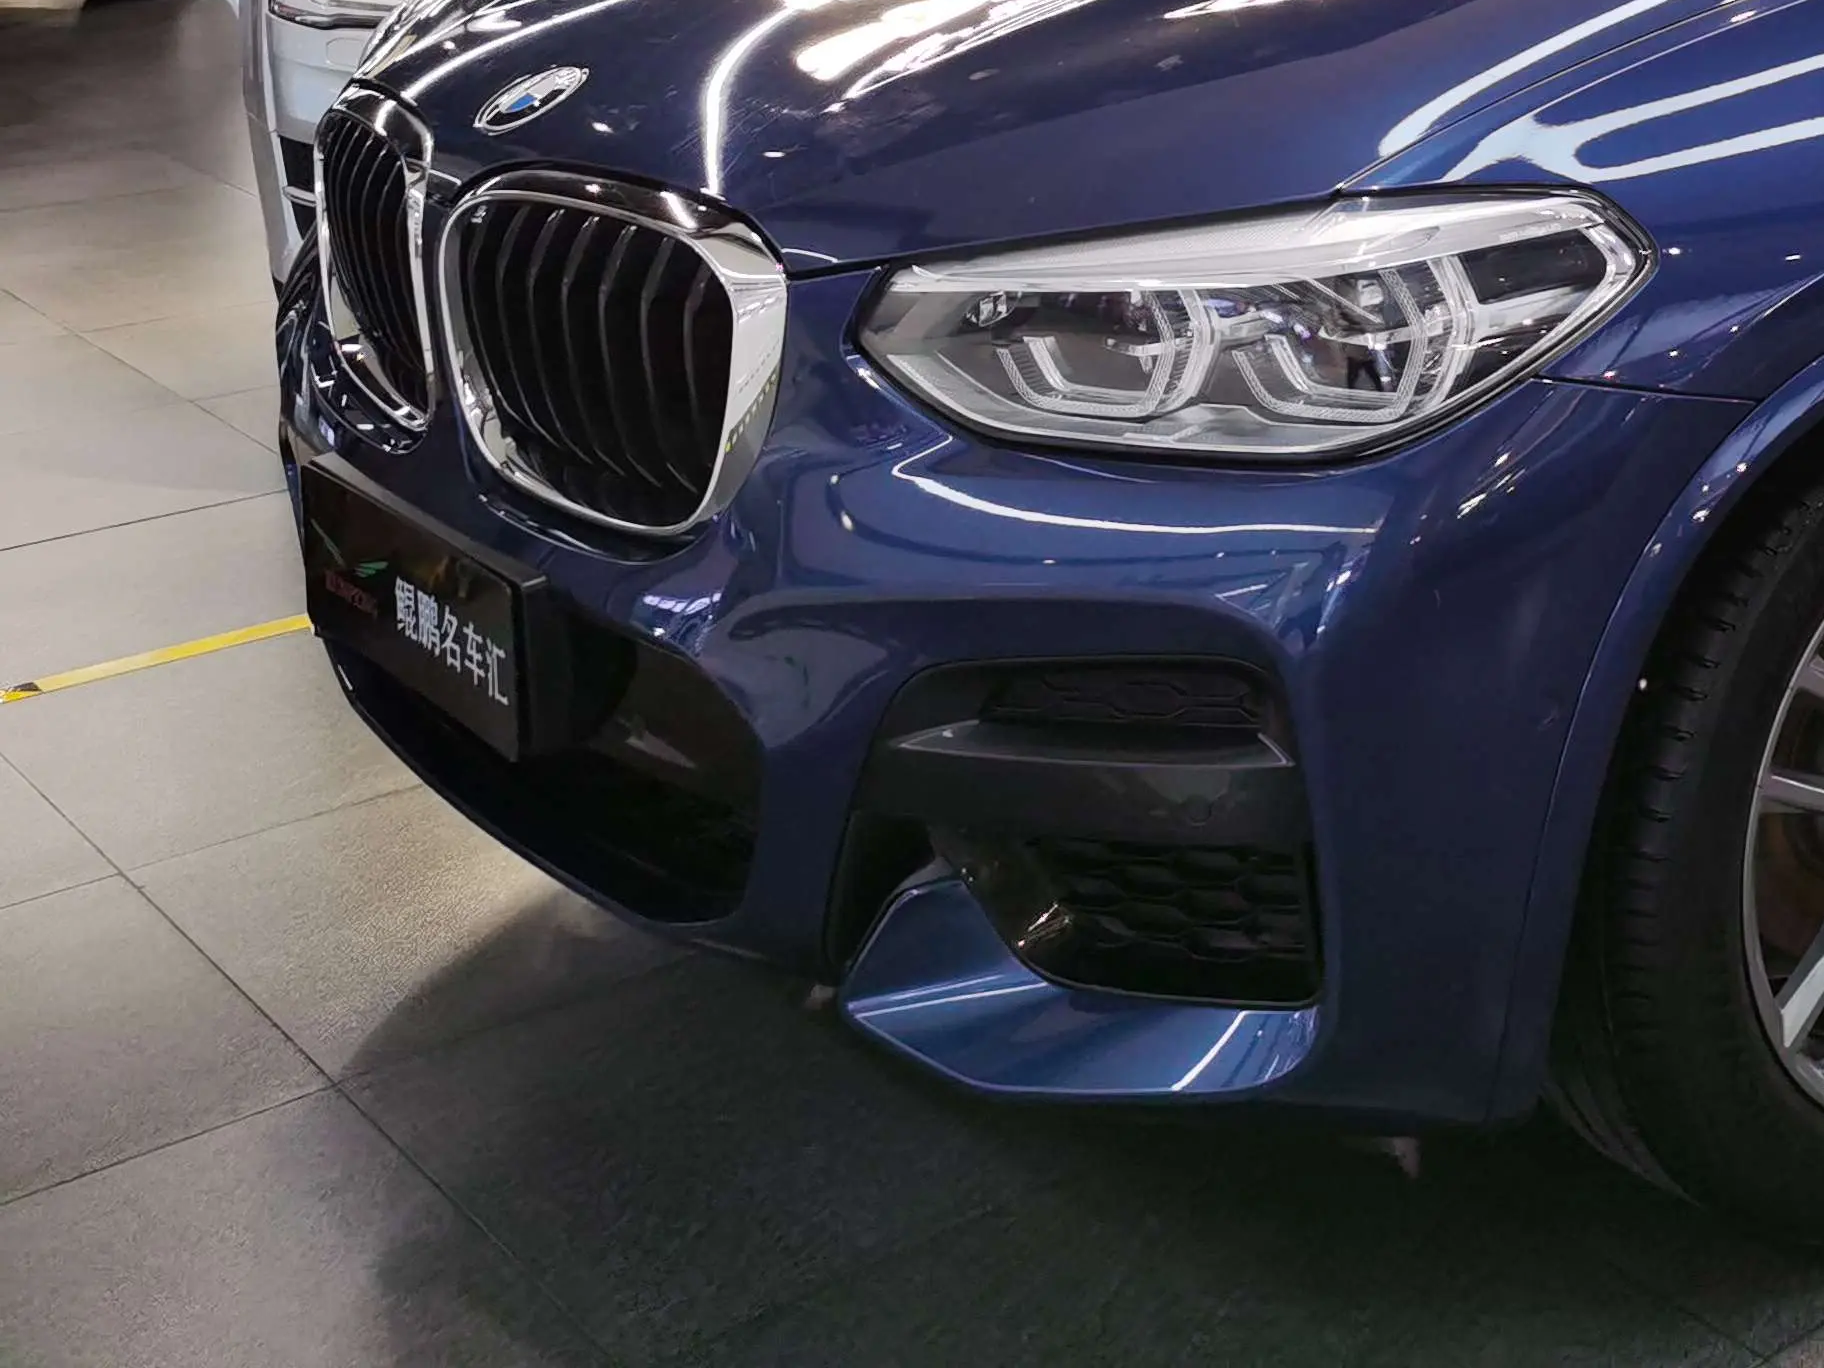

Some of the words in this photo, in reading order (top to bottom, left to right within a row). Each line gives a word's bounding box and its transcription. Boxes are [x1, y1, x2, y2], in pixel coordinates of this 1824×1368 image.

[395, 575, 509, 706] 鲲鹏名车汇
